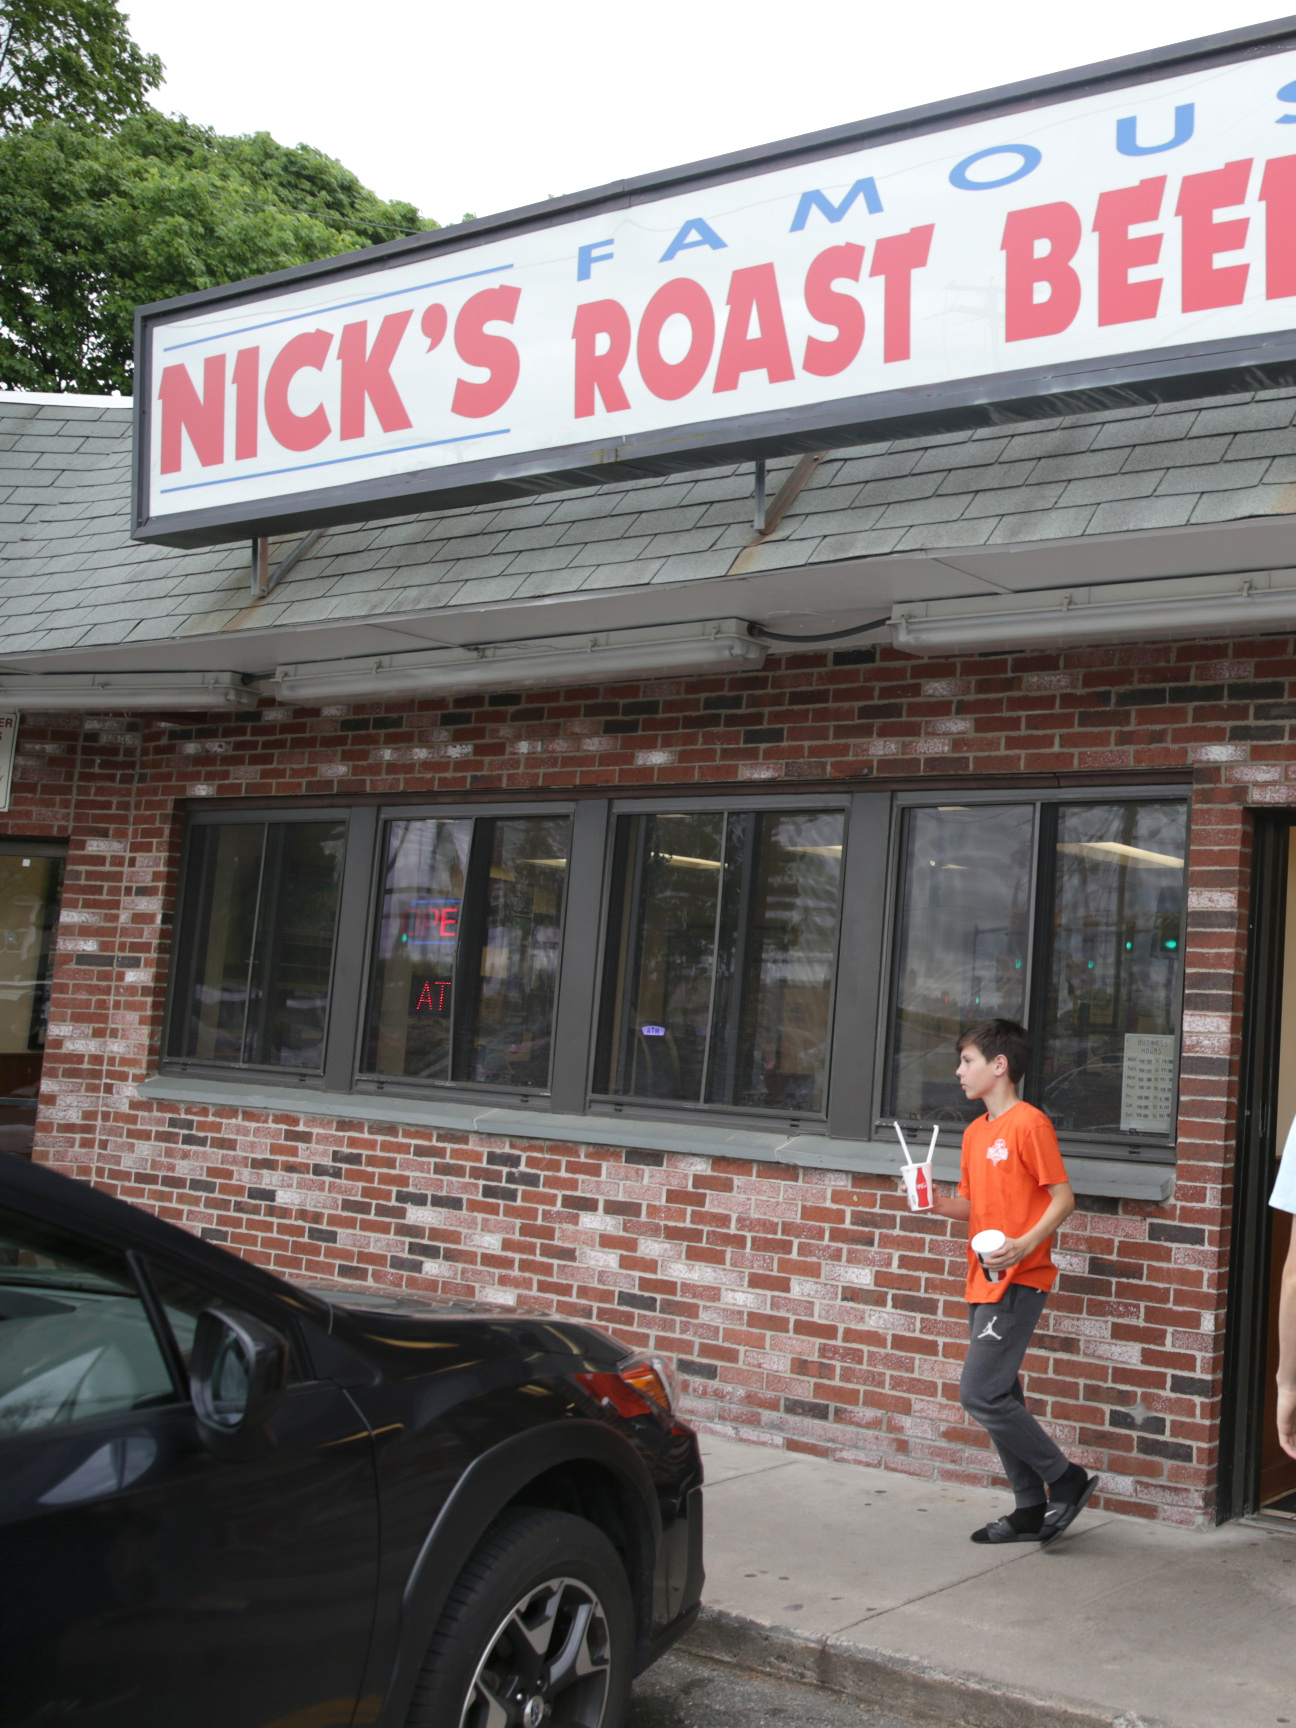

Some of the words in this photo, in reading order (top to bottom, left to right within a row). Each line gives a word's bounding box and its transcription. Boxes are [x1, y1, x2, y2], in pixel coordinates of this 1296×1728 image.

[159, 285, 521, 475] NICK'S
[572, 224, 934, 419] ROAST
[401, 908, 459, 937] OPE
[416, 981, 452, 1011] AT
[1137, 1038, 1168, 1048] BUSINESS
[1141, 1047, 1162, 1055] HOURS
